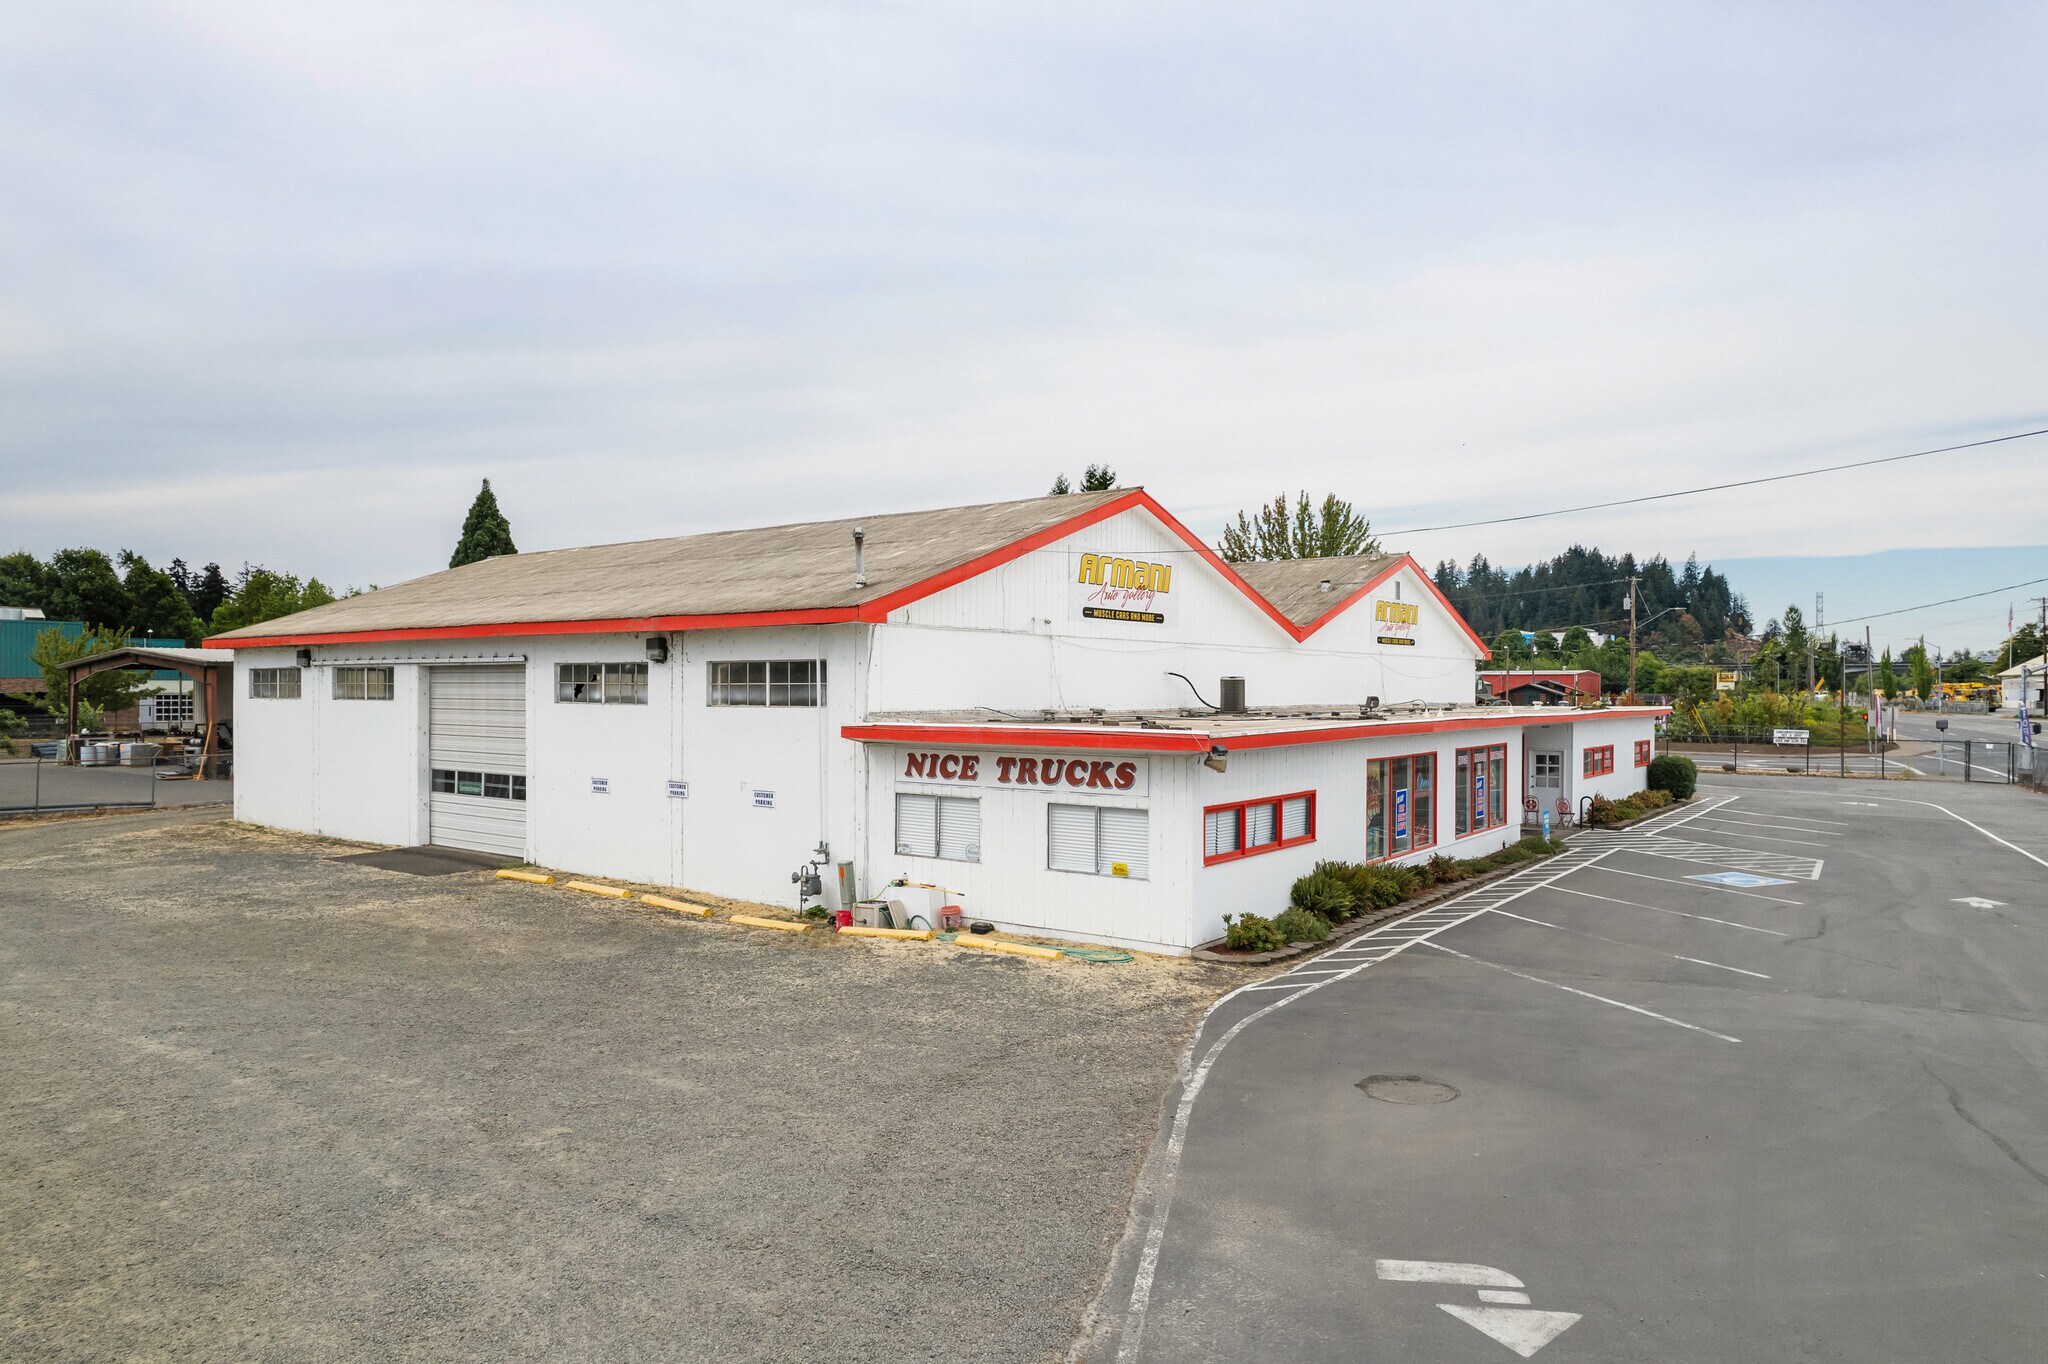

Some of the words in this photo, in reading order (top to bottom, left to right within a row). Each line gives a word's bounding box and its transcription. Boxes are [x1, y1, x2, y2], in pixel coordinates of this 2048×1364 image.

[1093, 608, 1115, 619] MUSCLE
[1116, 610, 1129, 620] CARS
[1130, 611, 1140, 621] AND
[1141, 613, 1155, 622] MORE
[904, 752, 981, 781] NICE
[996, 756, 1137, 790] TRUCKS
